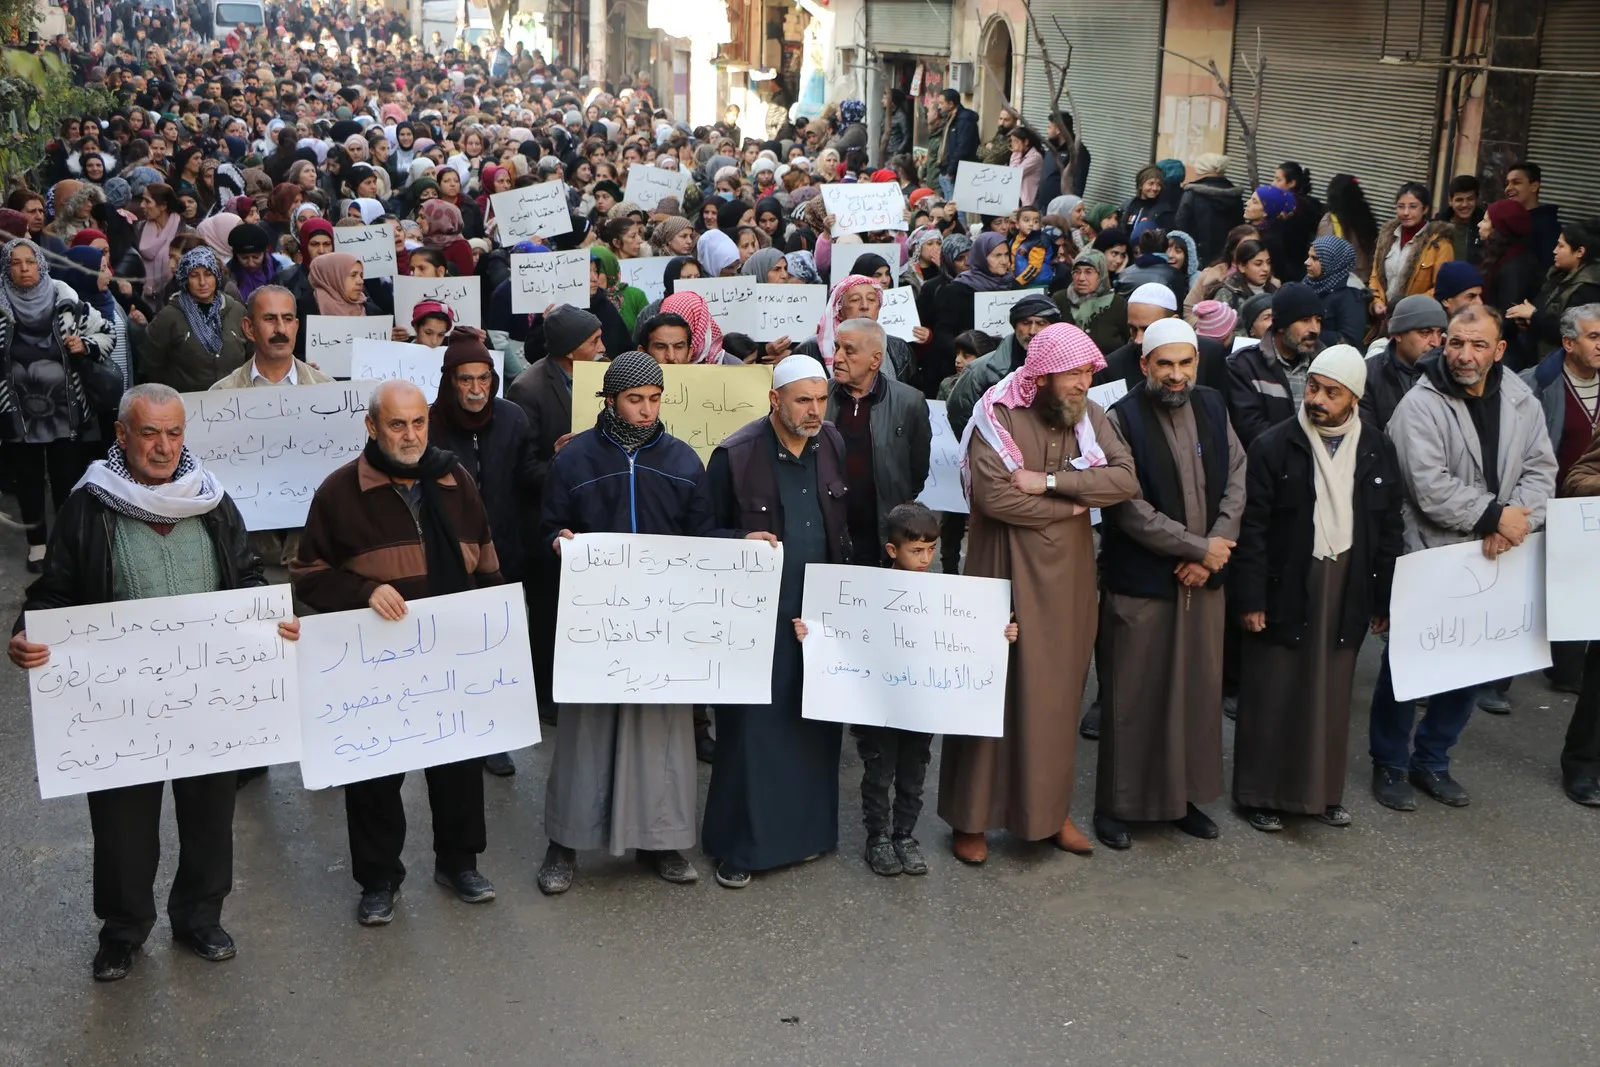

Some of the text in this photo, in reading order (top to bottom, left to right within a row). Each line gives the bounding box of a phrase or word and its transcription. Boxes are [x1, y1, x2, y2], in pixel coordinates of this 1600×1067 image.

[1001, 171, 1013, 185] لن
[335, 231, 373, 244] للحصا
[453, 286, 467, 301] لن
[521, 279, 555, 295] إرادتنا
[311, 332, 342, 349] حياة
[309, 390, 369, 421] طالب
[660, 382, 755, 415] حماية النف
[267, 434, 298, 460] على
[569, 543, 776, 578] نطالب بحرية التنقل
[1446, 554, 1501, 600] لا
[730, 590, 768, 614] بين
[838, 580, 868, 608] Em
[882, 588, 930, 616] Zarok
[49, 595, 286, 647] نطالب بسحب حواجز
[319, 600, 510, 674] لا للحصار
[566, 617, 671, 650] المحافظات
[821, 612, 852, 640] Em
[861, 629, 871, 644] ê
[892, 621, 919, 650] Her
[1419, 600, 1535, 652] للحصار الخانق
[137, 641, 208, 684] الرابعة
[214, 635, 286, 673] الفرقة
[94, 664, 127, 685] من
[606, 658, 722, 693] السورية
[922, 662, 971, 691] الأطفال
[972, 665, 995, 691] نحن
[208, 677, 286, 712] المؤدية
[315, 667, 521, 725] على الشيخ مقصود
[66, 697, 135, 738] الشيخ
[207, 726, 282, 758] مقصود
[333, 709, 466, 764] الأشرفية
